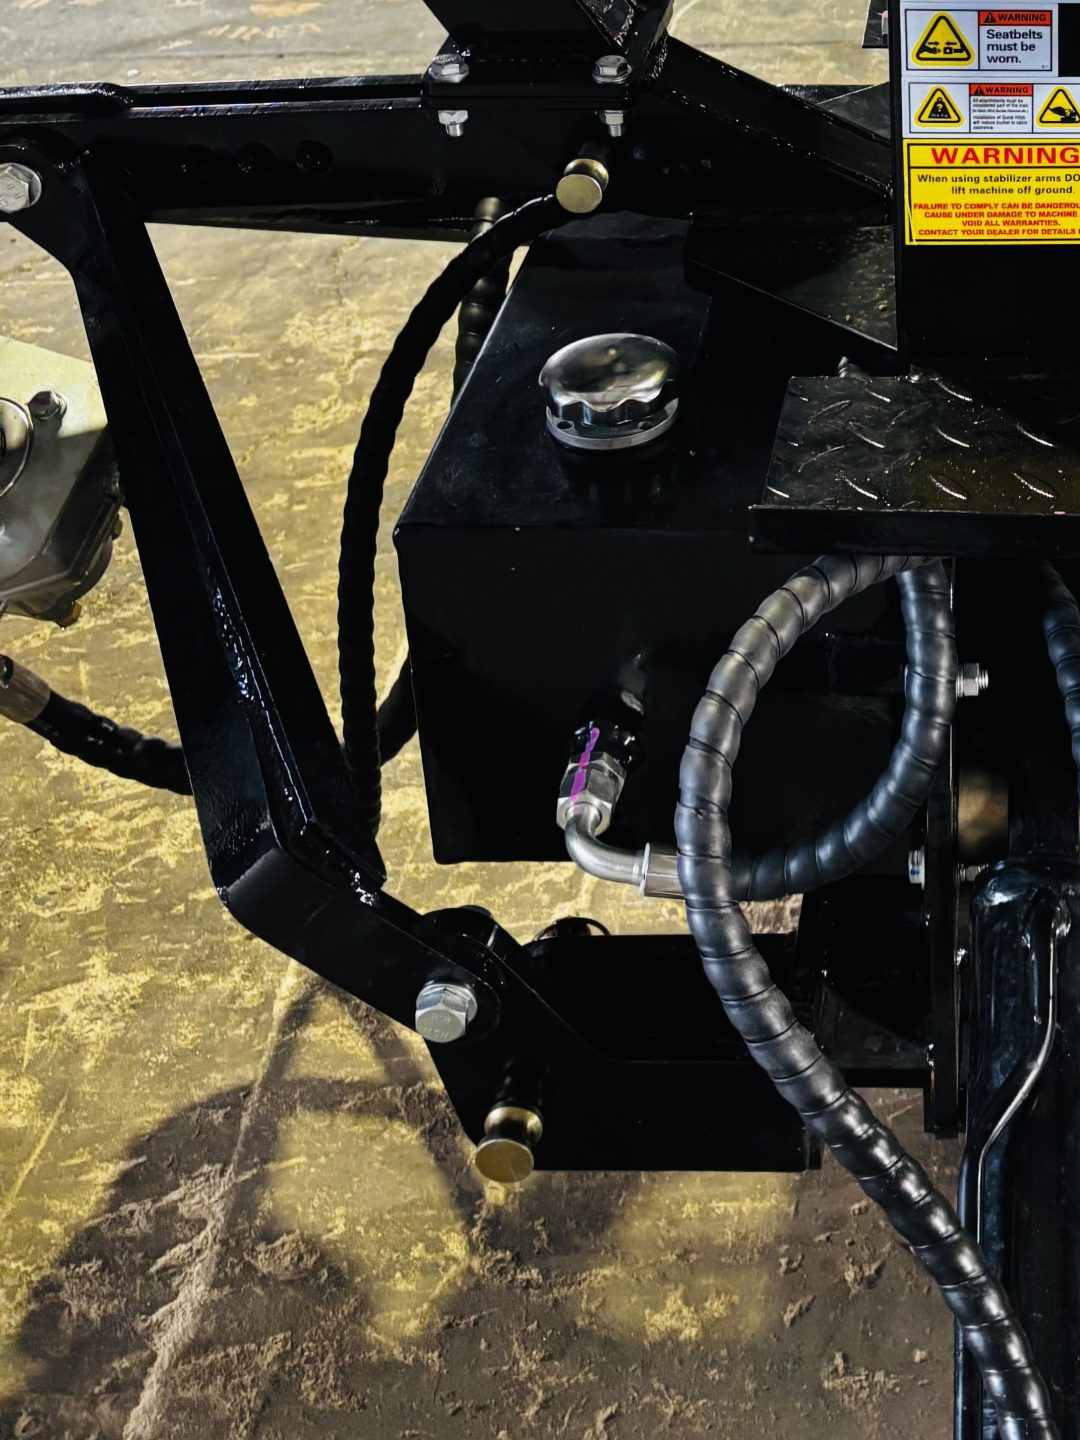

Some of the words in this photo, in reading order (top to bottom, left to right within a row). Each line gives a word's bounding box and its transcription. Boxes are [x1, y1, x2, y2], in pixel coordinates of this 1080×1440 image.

[998, 14, 1046, 22] WARNING
[986, 29, 1043, 40] Seatbelts
[987, 42, 1018, 52] must
[1021, 41, 1036, 51] be
[987, 55, 1022, 64] worn.
[917, 174, 948, 183] When
[951, 174, 980, 184] using
[983, 174, 1031, 183] stabilizer
[1064, 173, 1080, 182] DO
[951, 186, 966, 194] lift
[969, 186, 1014, 194] machine
[1017, 186, 1031, 194] off
[1034, 186, 1076, 195] ground.
